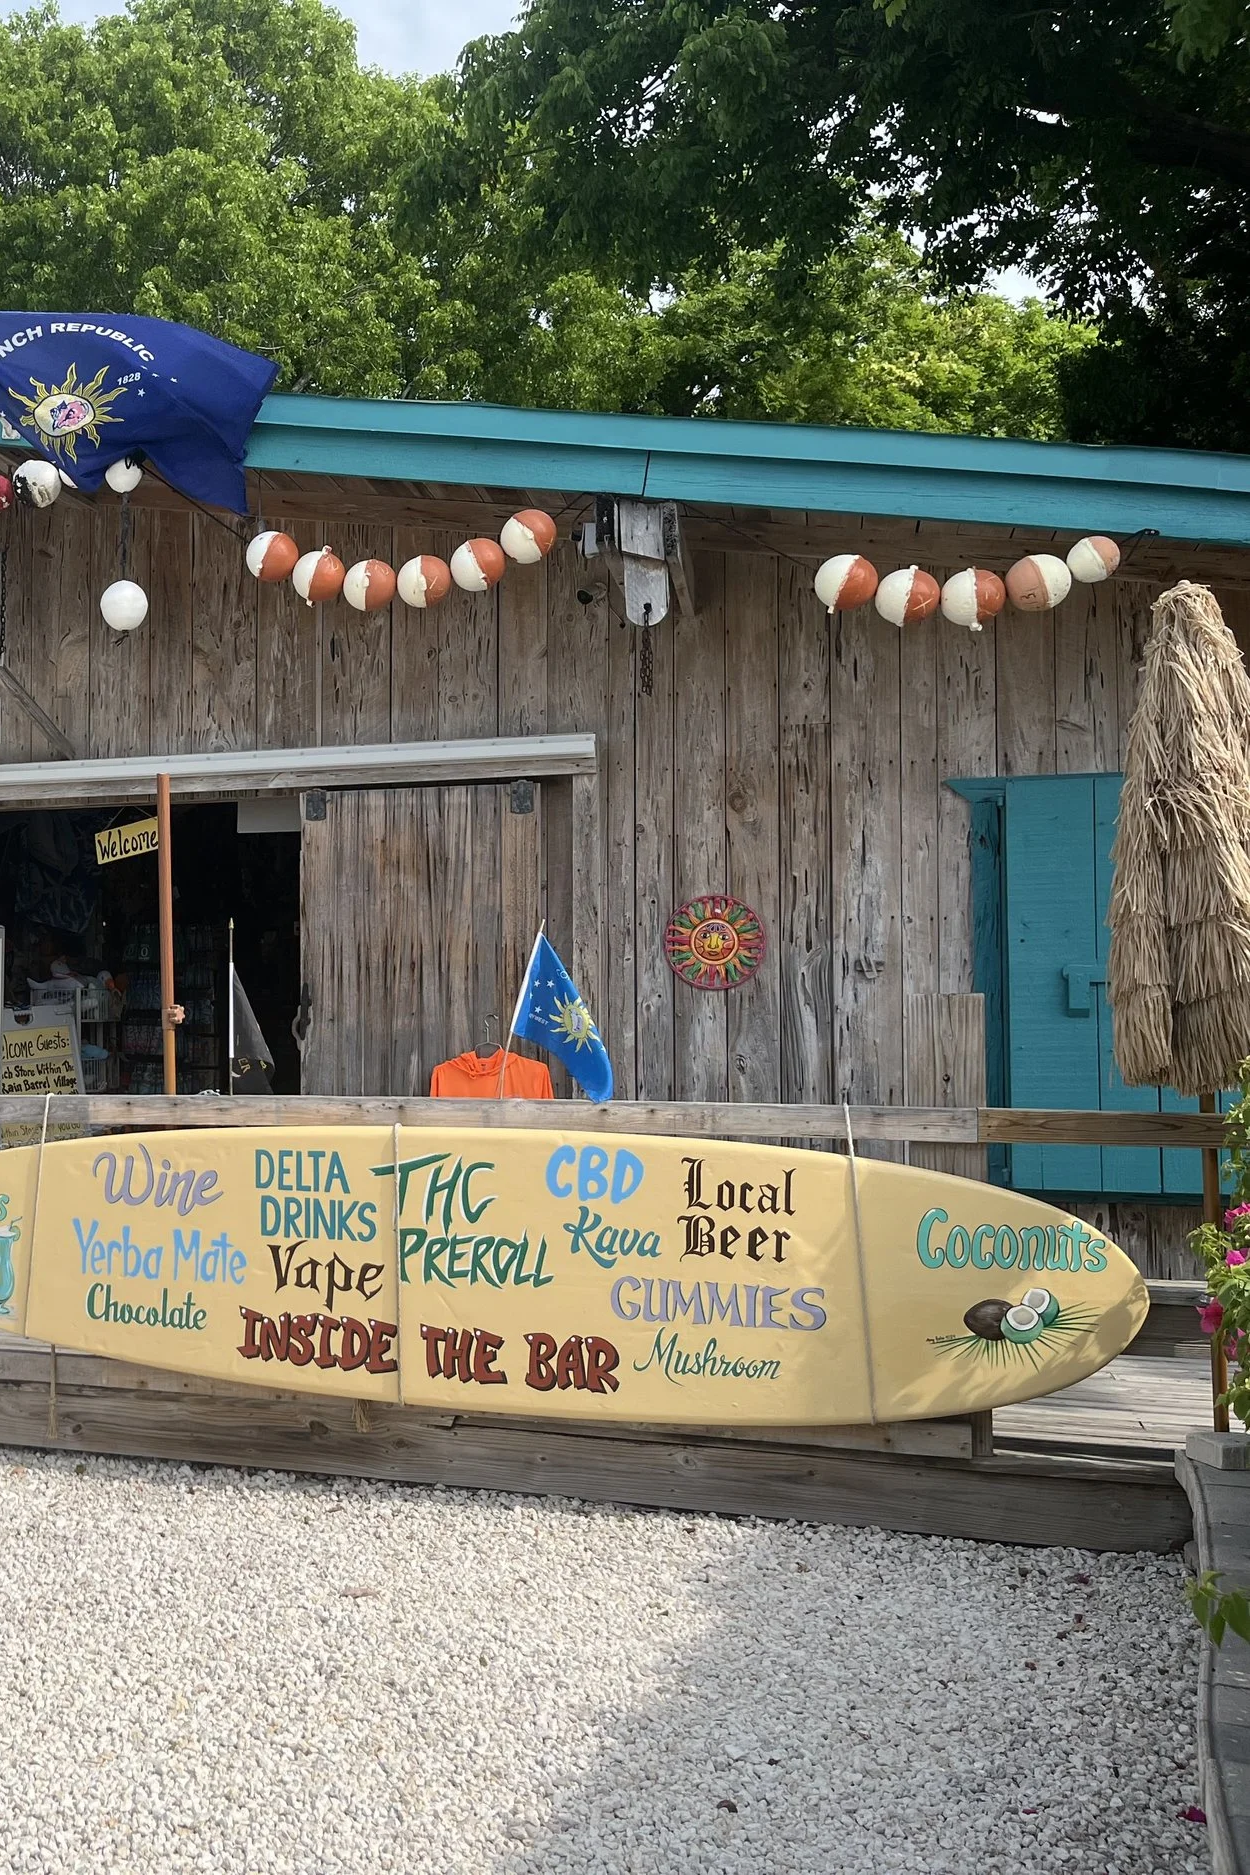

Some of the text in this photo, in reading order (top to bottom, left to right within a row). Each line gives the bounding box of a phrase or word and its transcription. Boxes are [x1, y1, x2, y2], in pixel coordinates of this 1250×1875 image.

[51, 322, 154, 362] REPUBLIC
[117, 372, 141, 386] 1828
[97, 829, 158, 860] Welcome
[2, 1066, 12, 1079] ch
[15, 1065, 35, 1078] Store
[36, 1062, 61, 1076] Within
[24, 1076, 50, 1091] Barrel
[54, 1075, 77, 1088] Village
[92, 1142, 225, 1217] Wine
[254, 1149, 351, 1195] DELTA
[366, 1152, 498, 1239] THC
[544, 1144, 646, 1204] CBD
[680, 1156, 796, 1217] Local
[260, 1194, 378, 1243] DRINKS
[562, 1205, 663, 1269] Kava
[678, 1213, 792, 1265] Beer
[916, 1206, 1109, 1274] Coconuts
[71, 1217, 248, 1286] Yerba Mate
[266, 1240, 386, 1313] Vape
[399, 1227, 555, 1291] PREROLL
[84, 1282, 208, 1332] Chocolate
[609, 1275, 828, 1332] GUMMIES
[235, 1304, 622, 1396] INSIDE THE BAR
[632, 1326, 784, 1385] Mushroom
